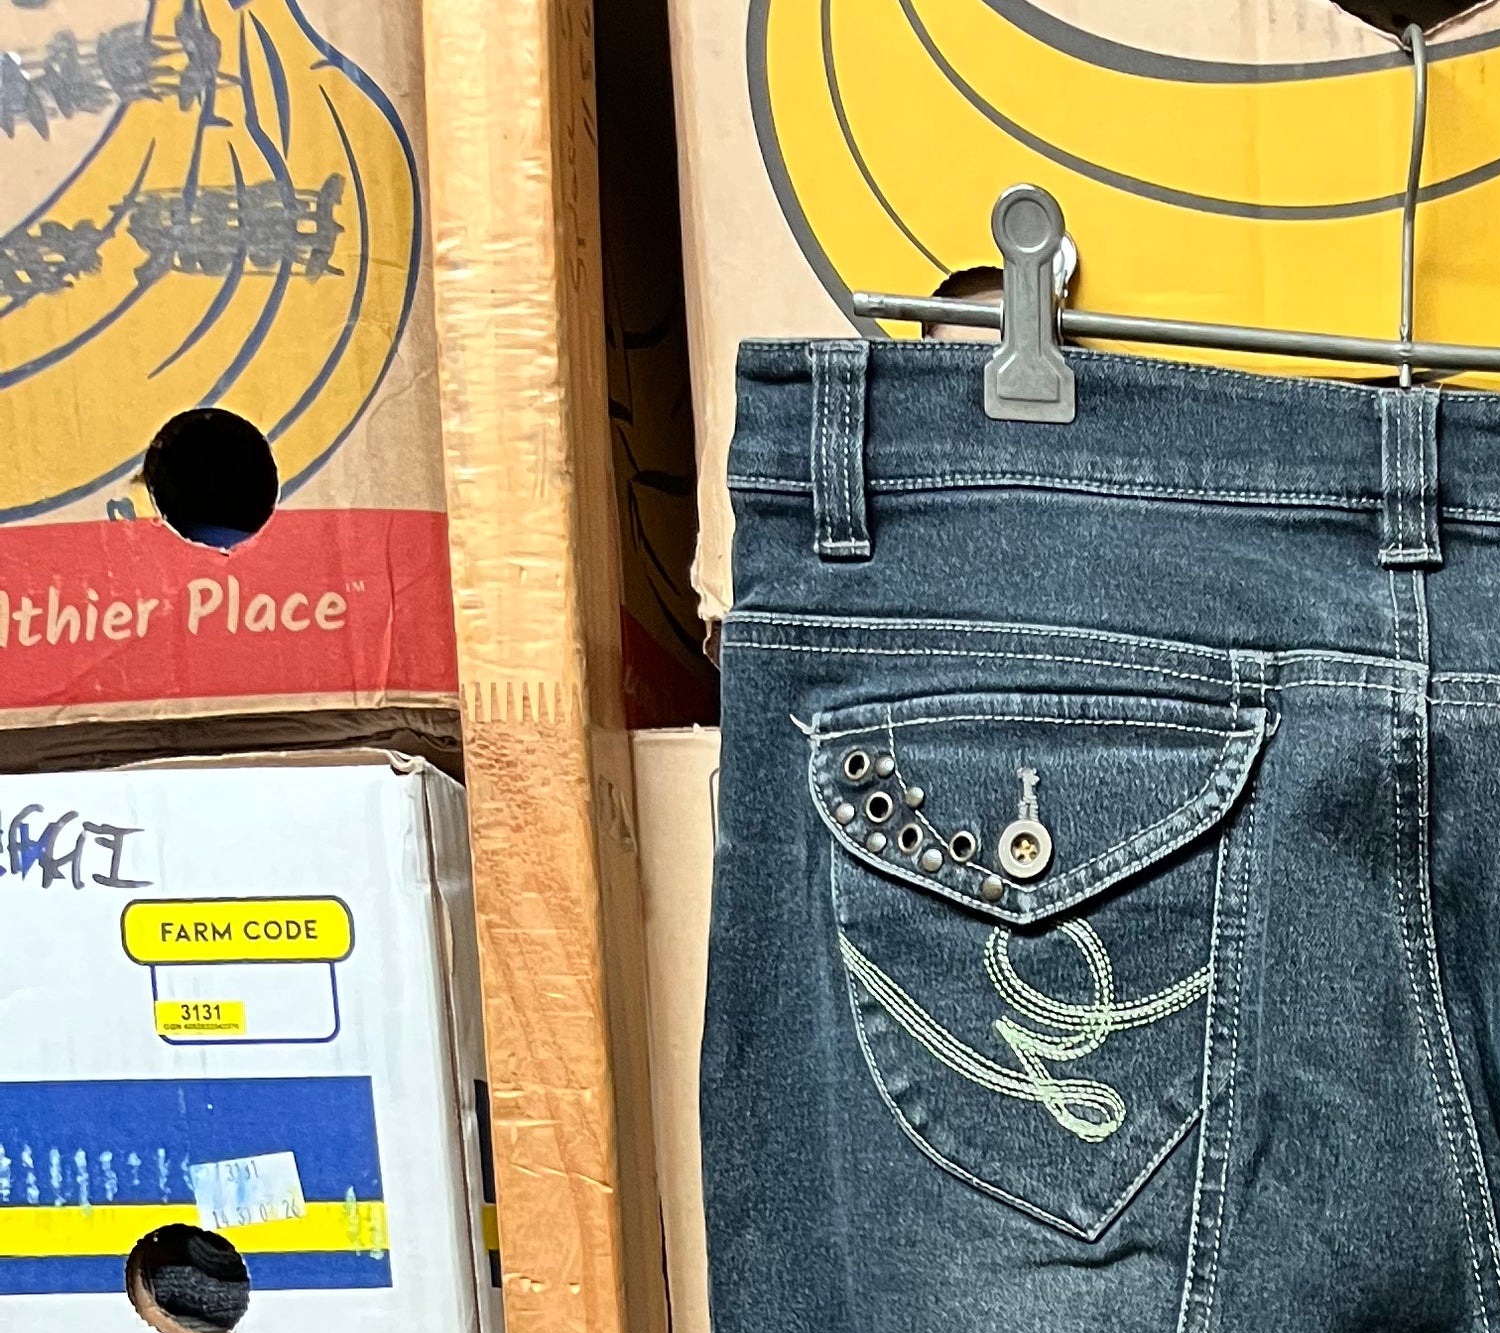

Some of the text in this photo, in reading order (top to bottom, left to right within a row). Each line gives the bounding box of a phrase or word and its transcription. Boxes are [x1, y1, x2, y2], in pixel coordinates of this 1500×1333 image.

[161, 919, 318, 943] FARM CODE
[180, 1004, 221, 1022] 3131
